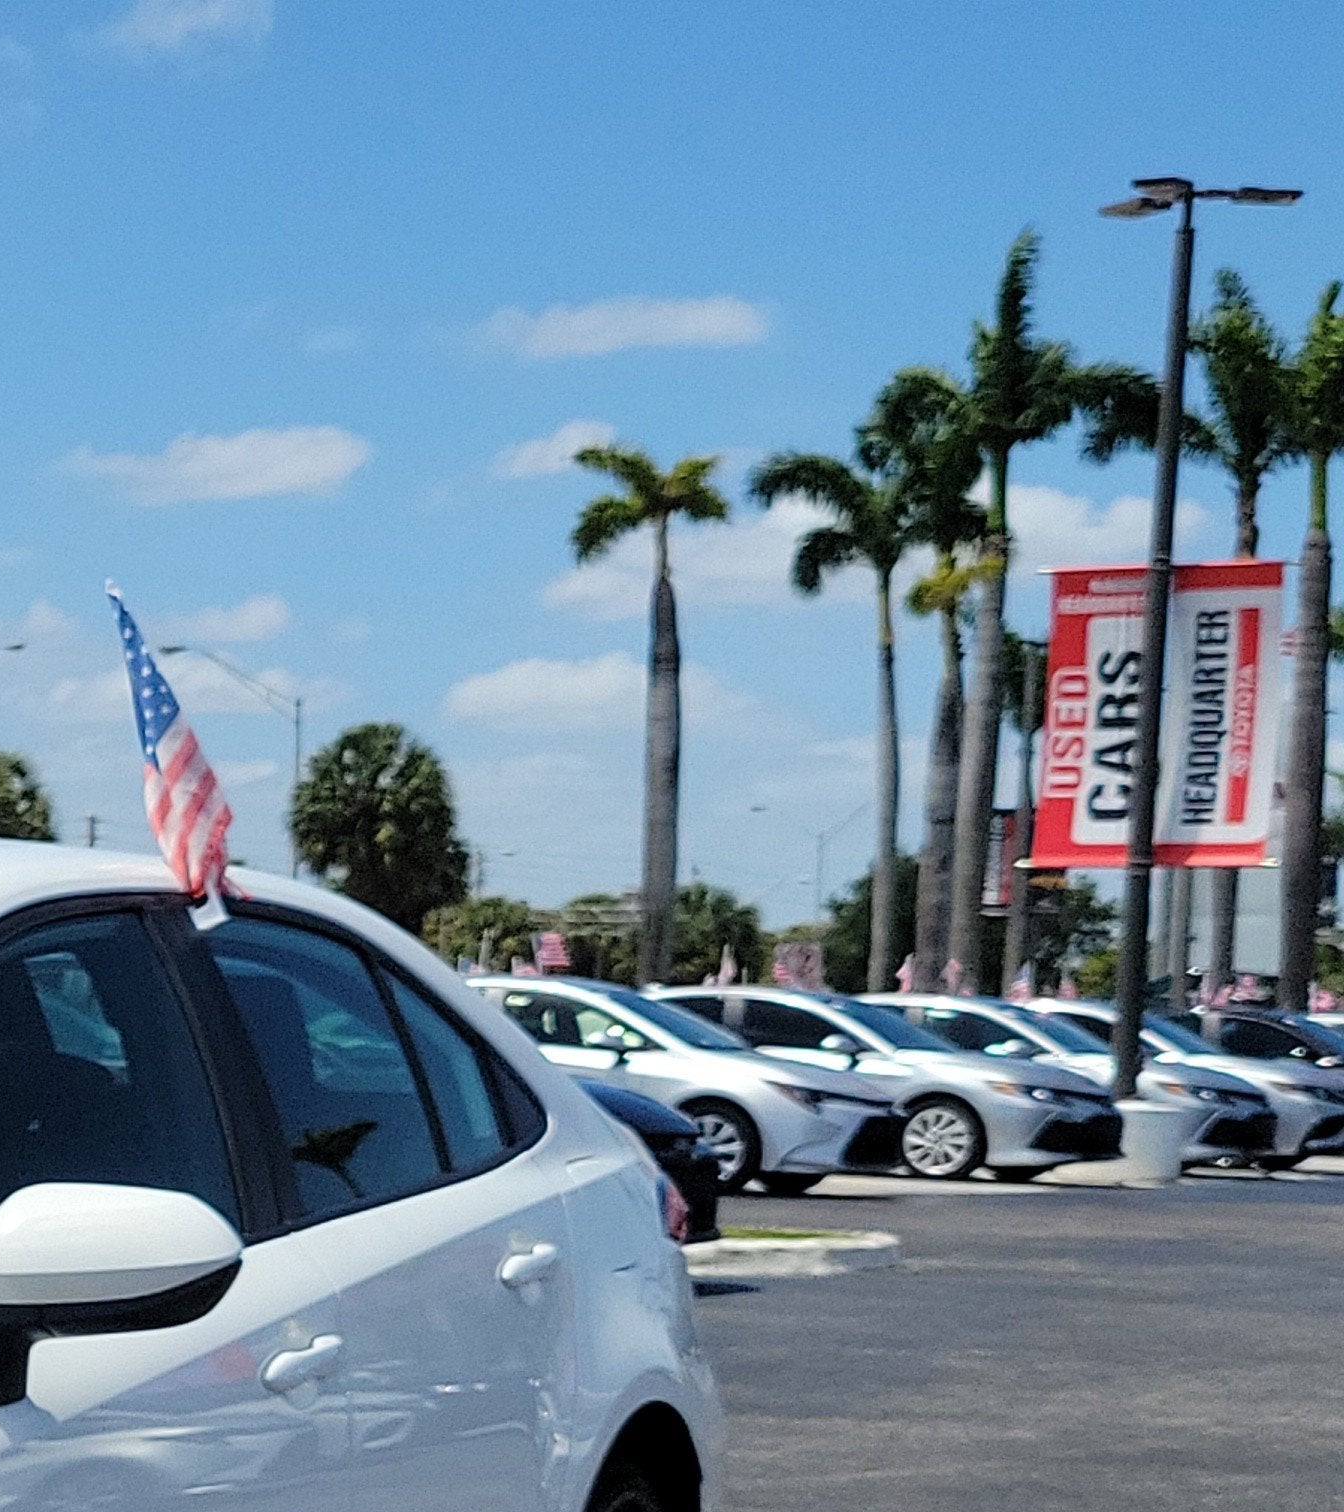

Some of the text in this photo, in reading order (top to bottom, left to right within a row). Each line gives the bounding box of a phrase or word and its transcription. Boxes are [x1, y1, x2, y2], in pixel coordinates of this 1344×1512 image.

[1051, 671, 1088, 793] USED
[1087, 651, 1145, 821] CARS
[1182, 610, 1230, 824] HEADQUARTER
[1230, 664, 1257, 749] TOYOTA
